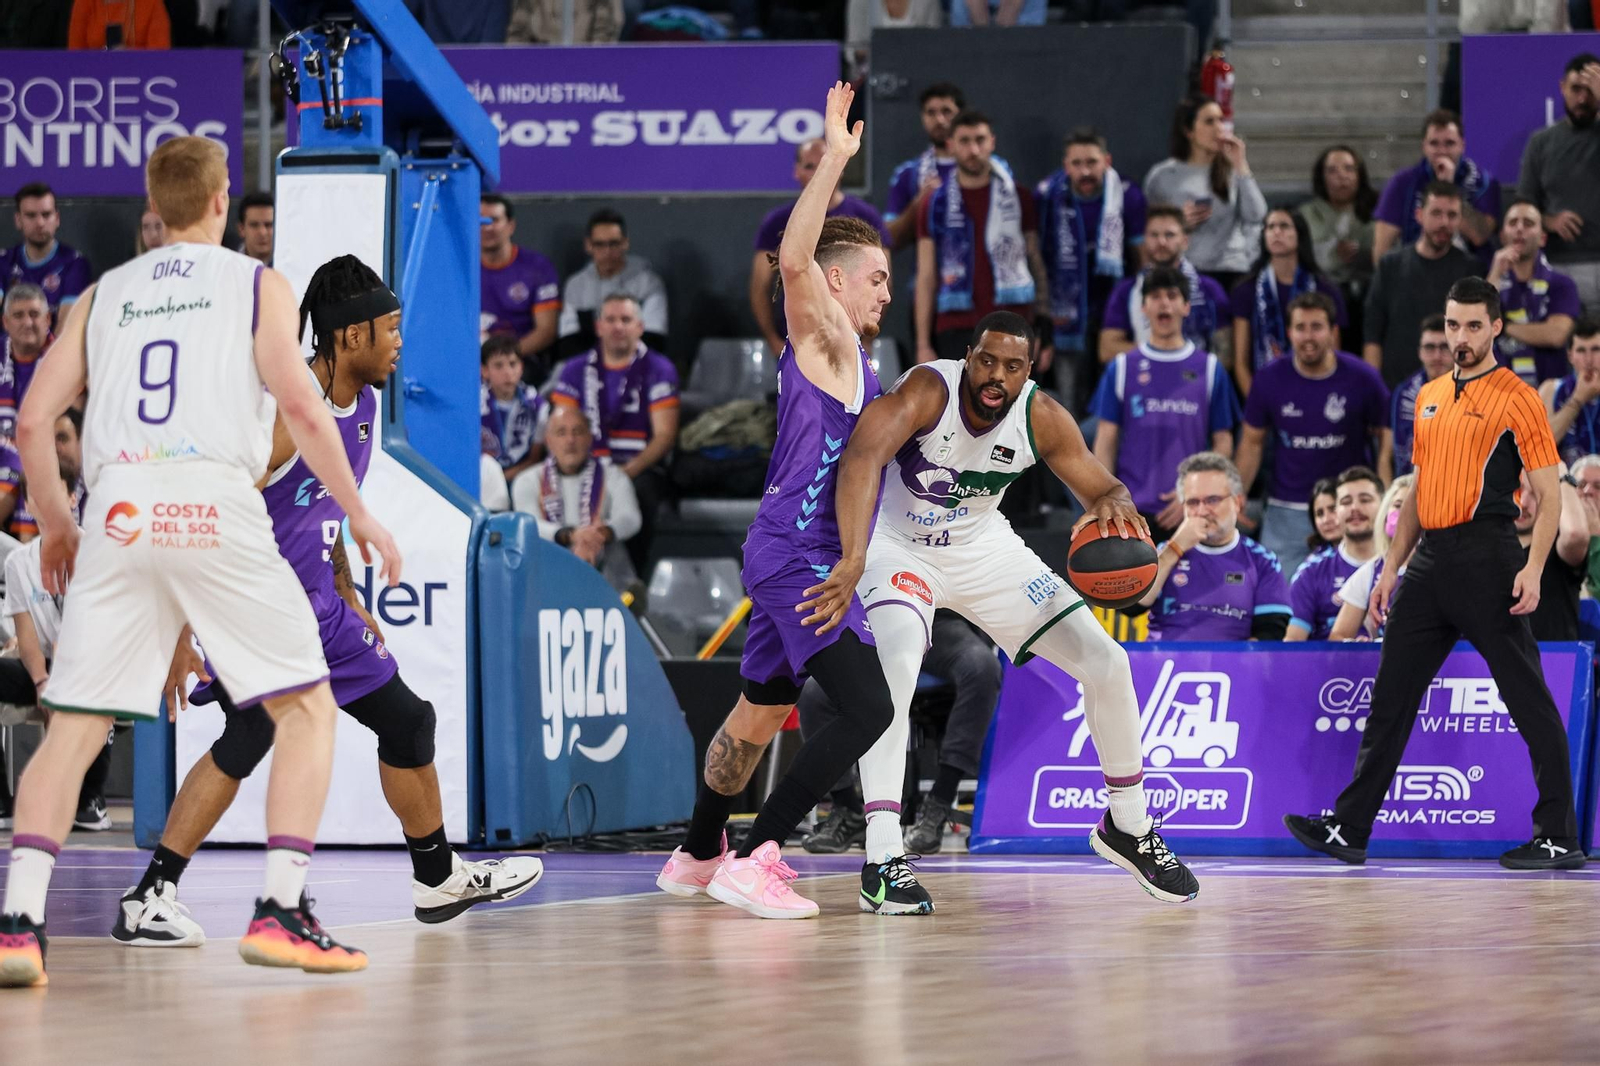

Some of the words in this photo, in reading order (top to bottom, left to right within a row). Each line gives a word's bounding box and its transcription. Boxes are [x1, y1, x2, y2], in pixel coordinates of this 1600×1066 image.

[499, 82, 624, 104] INDUSTRIAL
[592, 109, 825, 146] SUAZO
[152, 256, 195, 281] DÍAZ
[138, 339, 179, 425] 9
[152, 503, 219, 519] COSTA
[152, 521, 183, 534] DEL
[188, 522, 221, 535] SOL
[322, 519, 341, 562] 9
[538, 607, 628, 761] gaza
[1421, 716, 1519, 733] WHEELS
